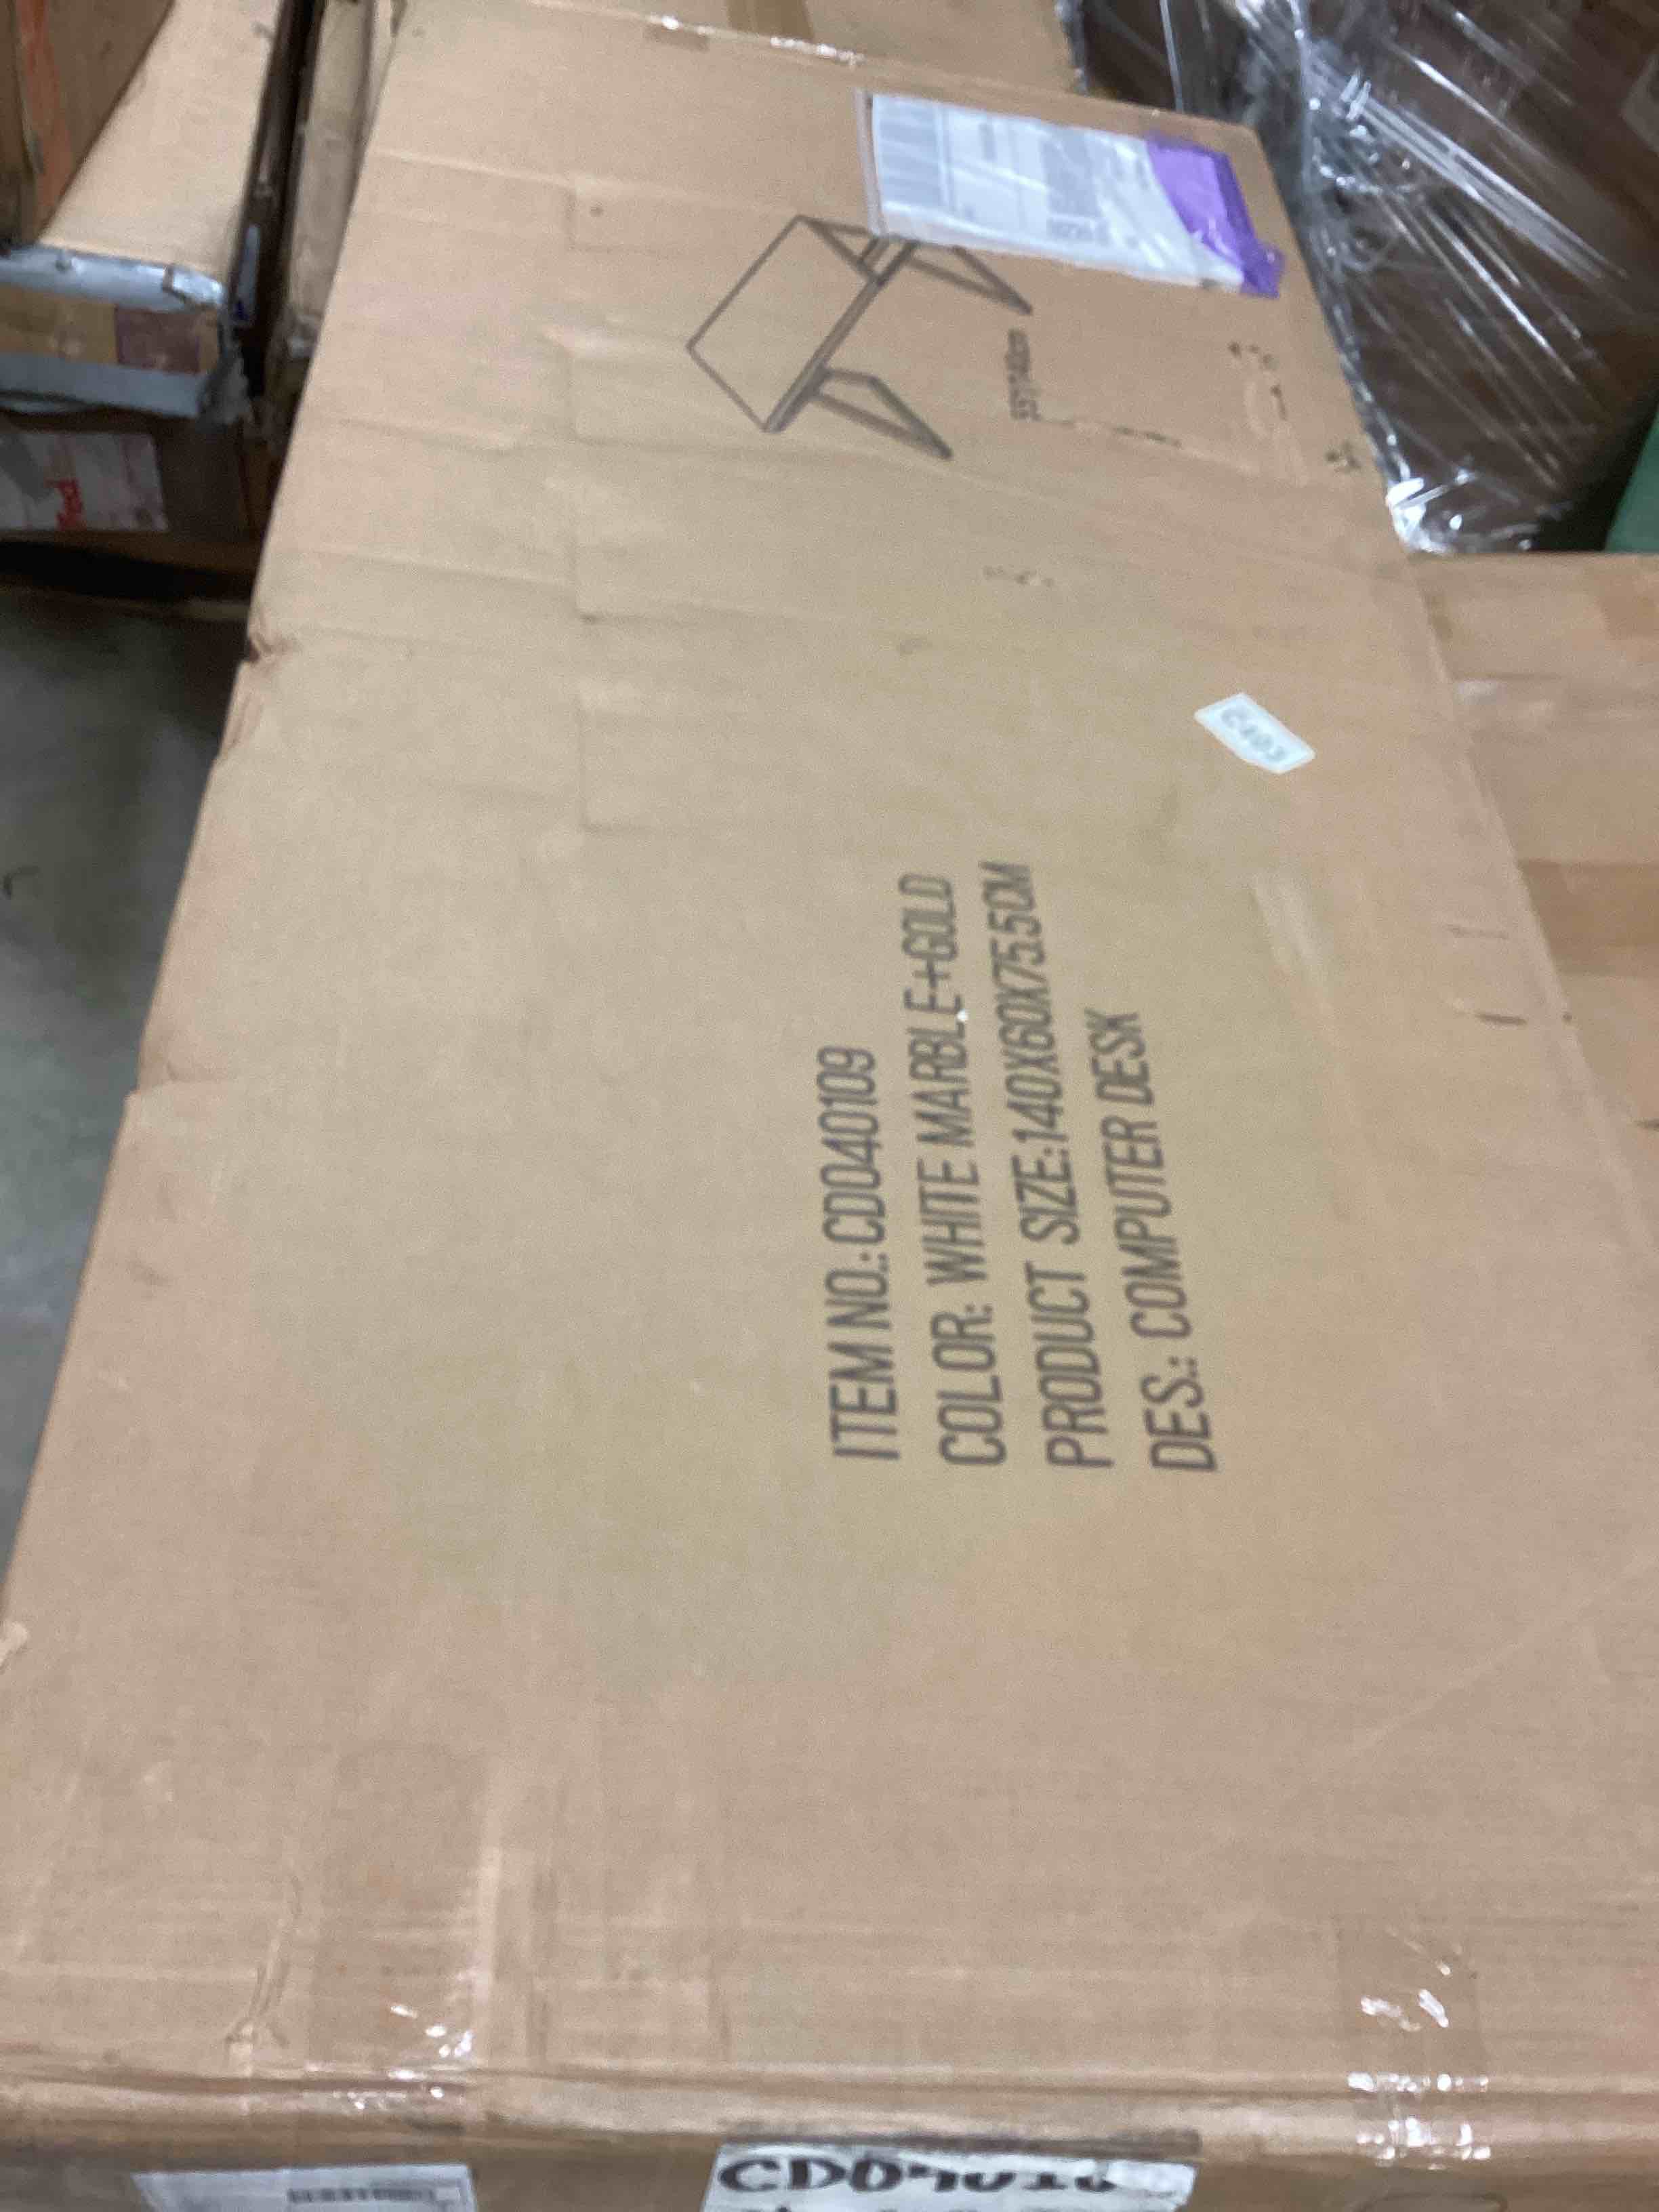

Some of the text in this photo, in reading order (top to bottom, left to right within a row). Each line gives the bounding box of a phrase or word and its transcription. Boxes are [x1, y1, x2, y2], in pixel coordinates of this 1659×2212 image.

[917, 1162, 987, 1285] WHITE
[1086, 1010, 1218, 1473] DES.: COMPUTER DESK
[827, 1342, 900, 1460] ITEM
[930, 1305, 1007, 1466] COLOR:
[1024, 1262, 1114, 1469] PRODUCT
